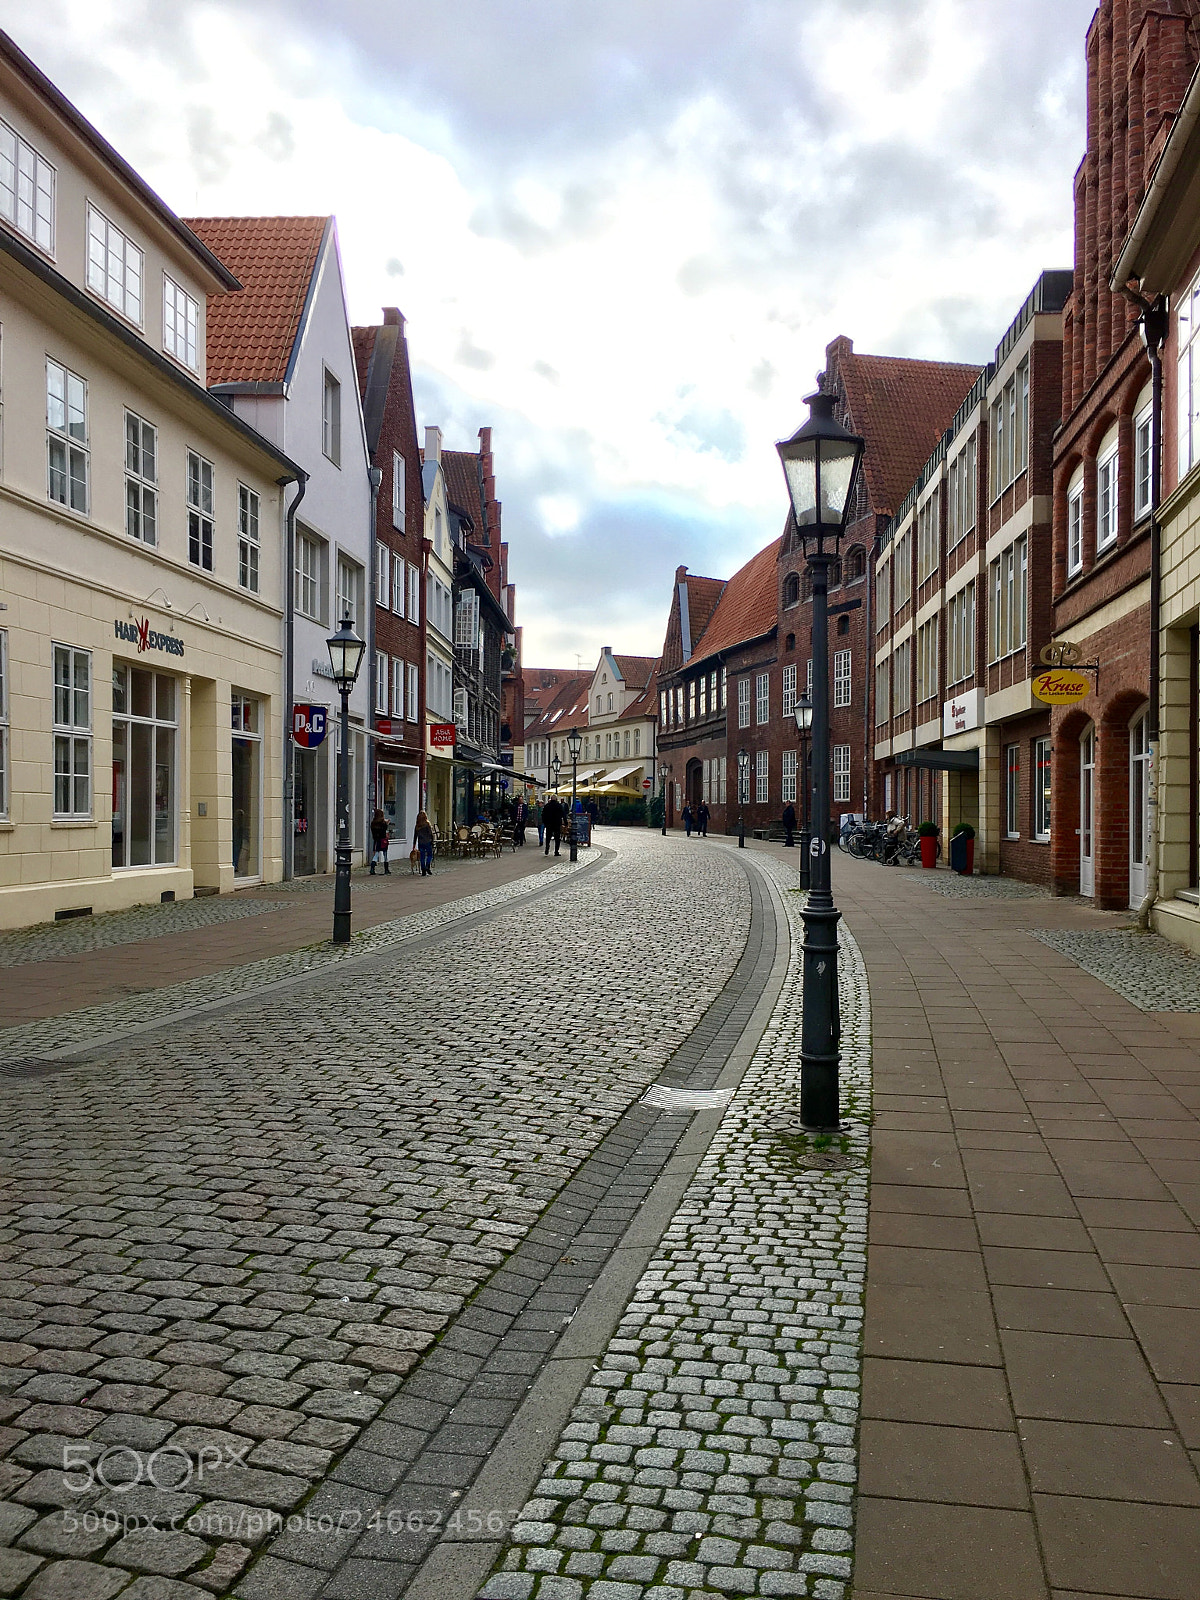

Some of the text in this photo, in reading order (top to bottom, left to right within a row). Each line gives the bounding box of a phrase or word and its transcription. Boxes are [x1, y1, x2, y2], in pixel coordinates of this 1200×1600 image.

[114, 619, 185, 657] HAIR EXPRESS
[1038, 676, 1084, 691] Kruse
[294, 714, 324, 733] P&C
